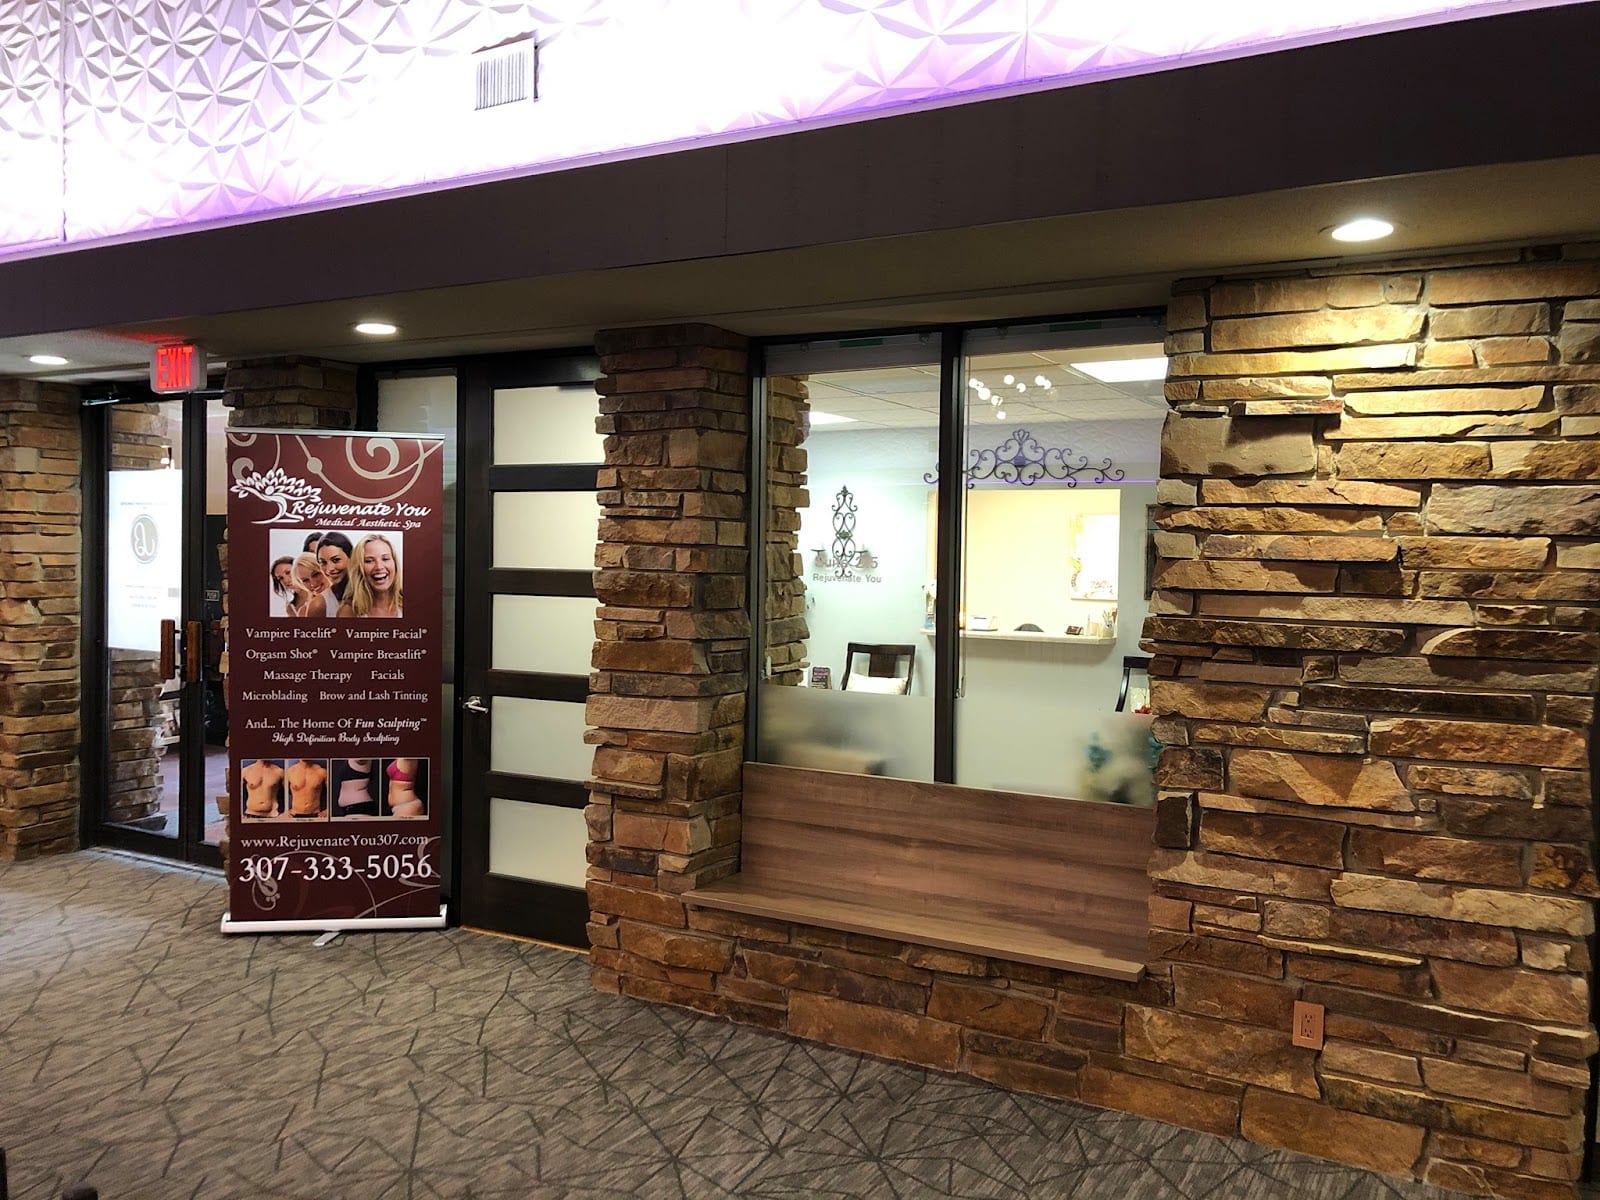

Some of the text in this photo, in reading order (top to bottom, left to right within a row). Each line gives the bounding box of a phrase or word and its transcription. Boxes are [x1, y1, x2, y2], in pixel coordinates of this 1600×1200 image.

[156, 347, 194, 389] EXIT
[291, 501, 431, 518] Rejuvenate You
[315, 518, 421, 530] Medical Aesthetic Spa
[812, 573, 882, 583] Rejuvenate You
[246, 628, 290, 641] Vampire
[346, 629, 389, 641] Vampire
[246, 649, 287, 662] Orgasm
[329, 649, 374, 662] Vampire
[263, 670, 352, 683] Massage Therapy
[371, 670, 405, 680] Facials
[242, 691, 308, 703] Microblading
[319, 691, 428, 703] Brow and Lash Tinting
[246, 719, 276, 729] And...
[278, 718, 299, 729] The
[303, 718, 335, 729] Home
[337, 718, 354, 729] Of
[355, 719, 375, 729] Fun
[272, 732, 400, 746] High Definition Body Sculpting
[241, 833, 429, 850] www.RejuvenateYou307.com
[239, 853, 433, 882] 307-333-5056
